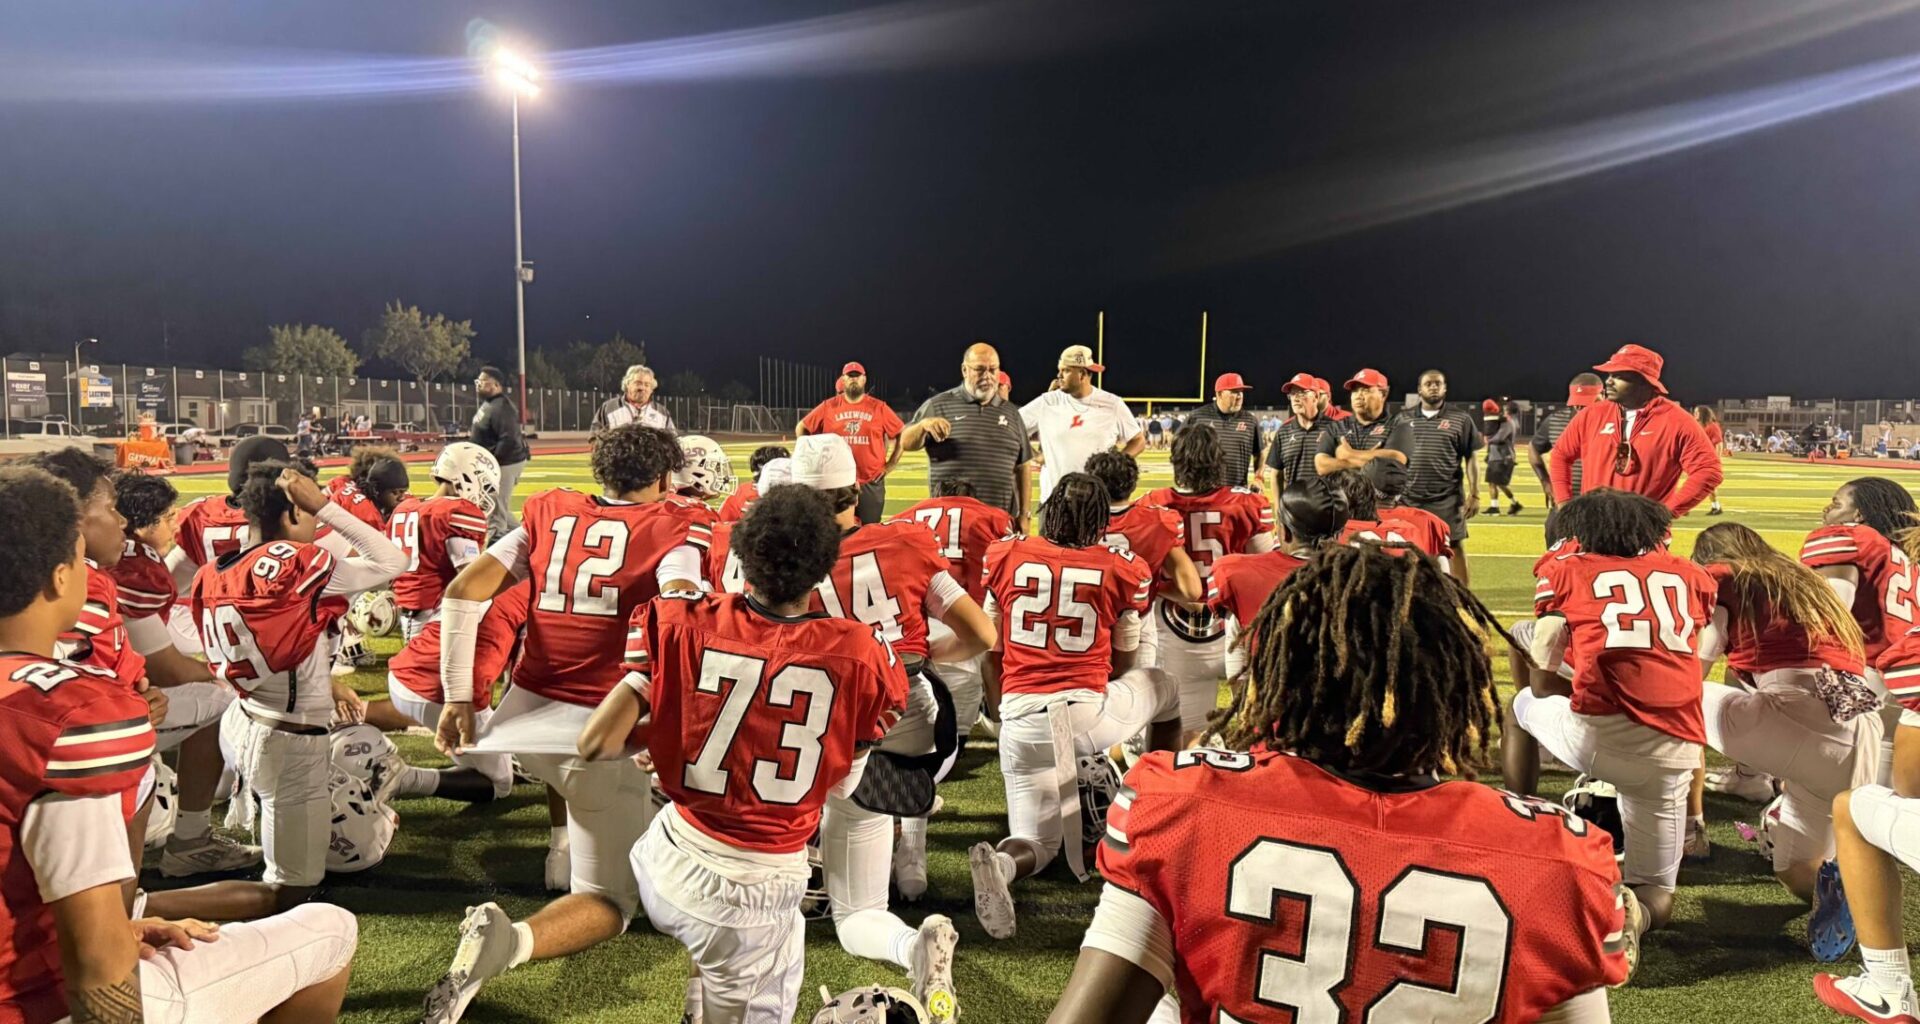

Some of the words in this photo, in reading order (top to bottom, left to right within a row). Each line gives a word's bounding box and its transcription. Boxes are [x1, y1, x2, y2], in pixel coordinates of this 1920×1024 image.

[834, 410, 873, 422] LAKEWOOD
[1069, 414, 1084, 430] L
[536, 514, 630, 616] 12
[914, 506, 964, 559] 71
[1009, 560, 1104, 655] 25
[1591, 568, 1696, 655] 20
[1884, 543, 1920, 624] 2
[202, 604, 276, 692] 99
[343, 741, 372, 757] 250
[683, 646, 838, 807] 73
[1215, 835, 1515, 1024] 32
